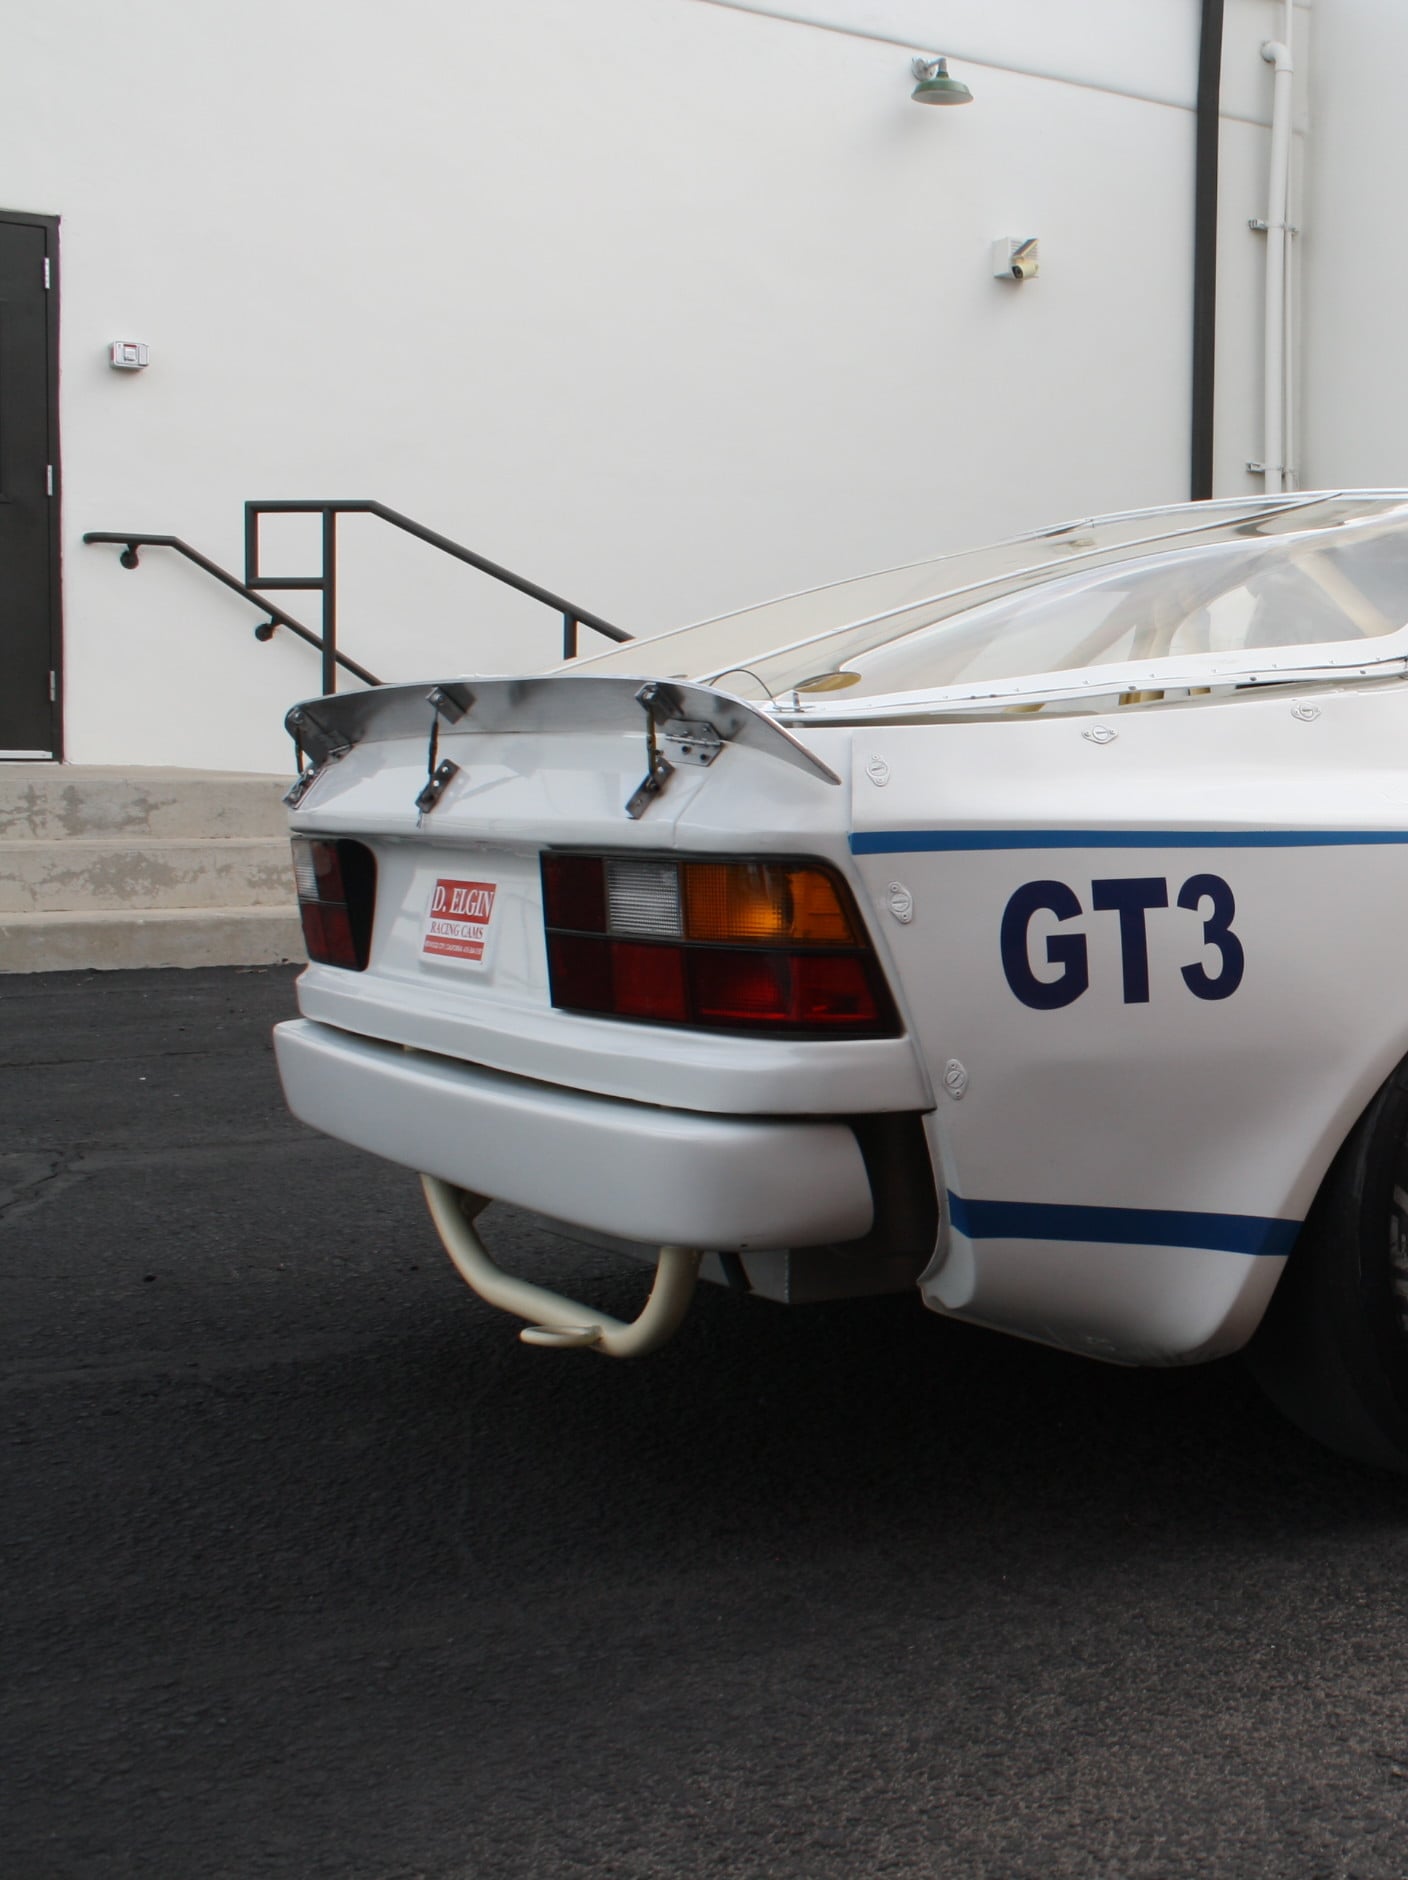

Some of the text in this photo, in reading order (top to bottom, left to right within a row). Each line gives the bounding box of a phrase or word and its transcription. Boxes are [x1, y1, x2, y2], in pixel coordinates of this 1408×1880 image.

[432, 886, 493, 917] D. ELGIN
[431, 921, 483, 939] RACING CAMS
[1000, 873, 1245, 1011] GT3
